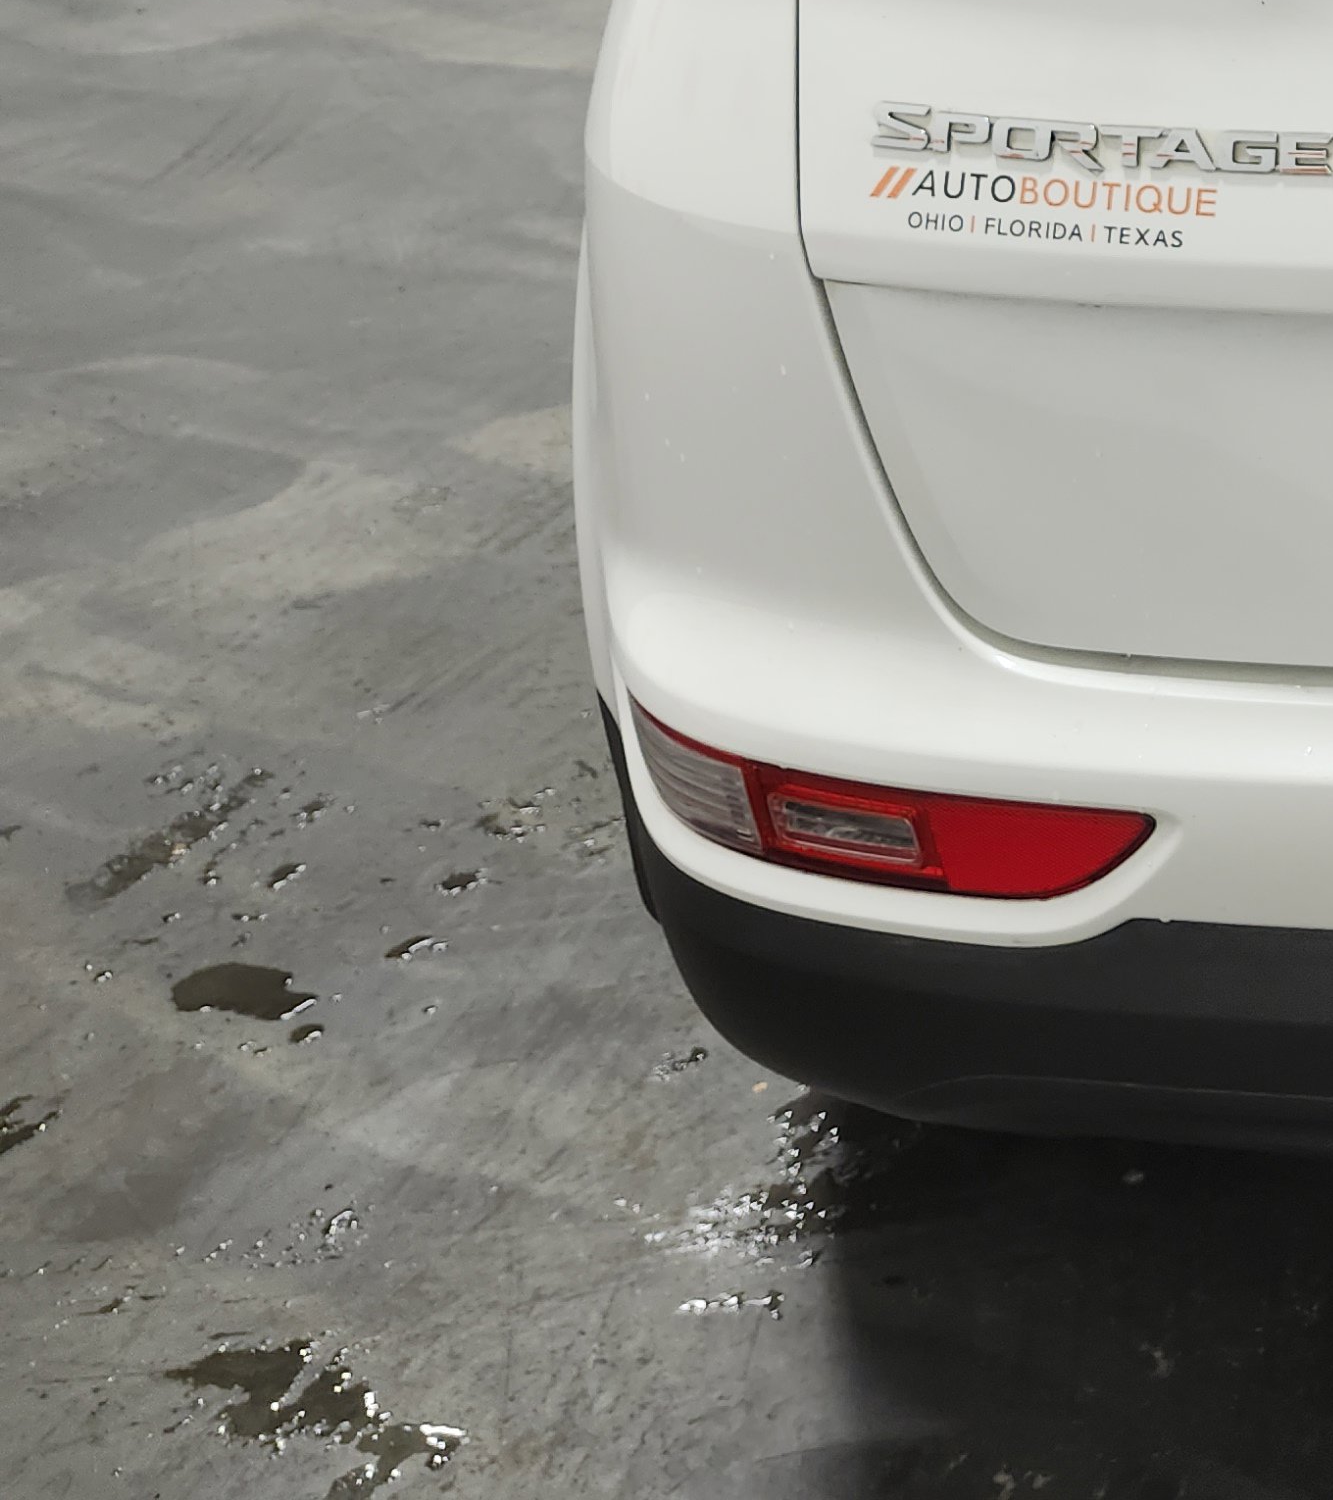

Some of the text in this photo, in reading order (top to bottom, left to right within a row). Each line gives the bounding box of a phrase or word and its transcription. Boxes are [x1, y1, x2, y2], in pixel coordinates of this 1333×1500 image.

[872, 100, 1333, 176] SPORTAGE
[908, 211, 1184, 248] OHIO FLORIDA TEXAS
